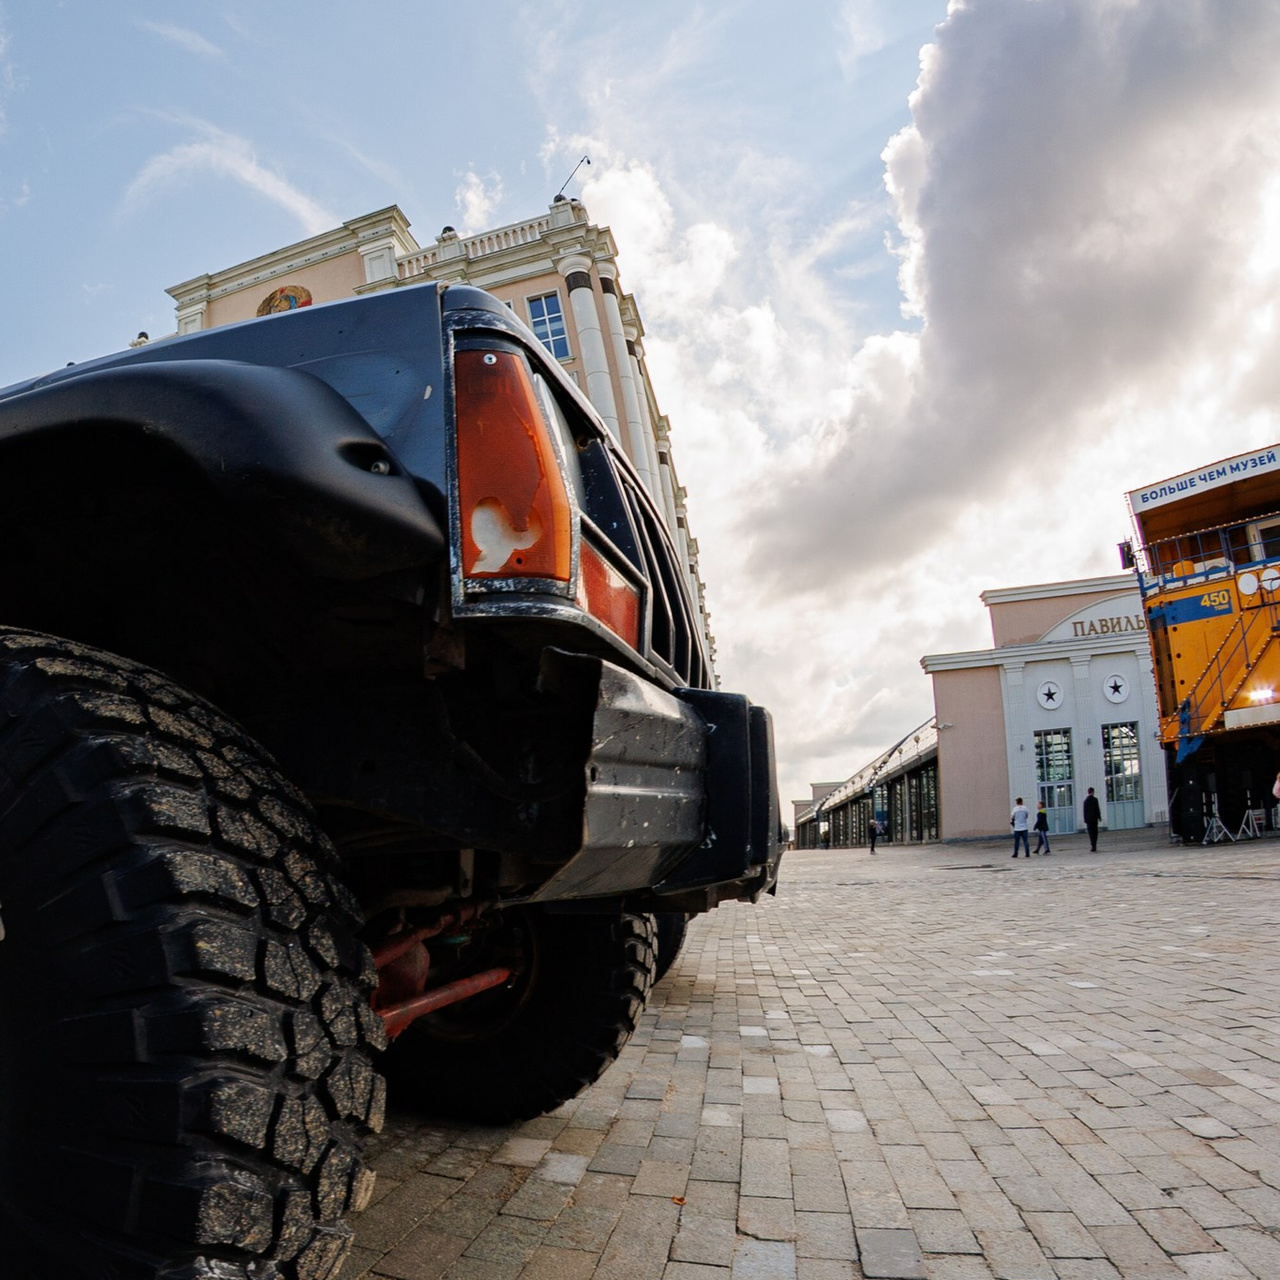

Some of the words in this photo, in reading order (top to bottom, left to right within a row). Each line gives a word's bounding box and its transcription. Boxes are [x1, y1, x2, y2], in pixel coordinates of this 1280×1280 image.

[1141, 478, 1197, 503] БОЛЬШЕ
[1198, 467, 1227, 483] ЧЕМ
[1229, 451, 1277, 474] МУЗЕЙ
[1200, 590, 1230, 607] 450
